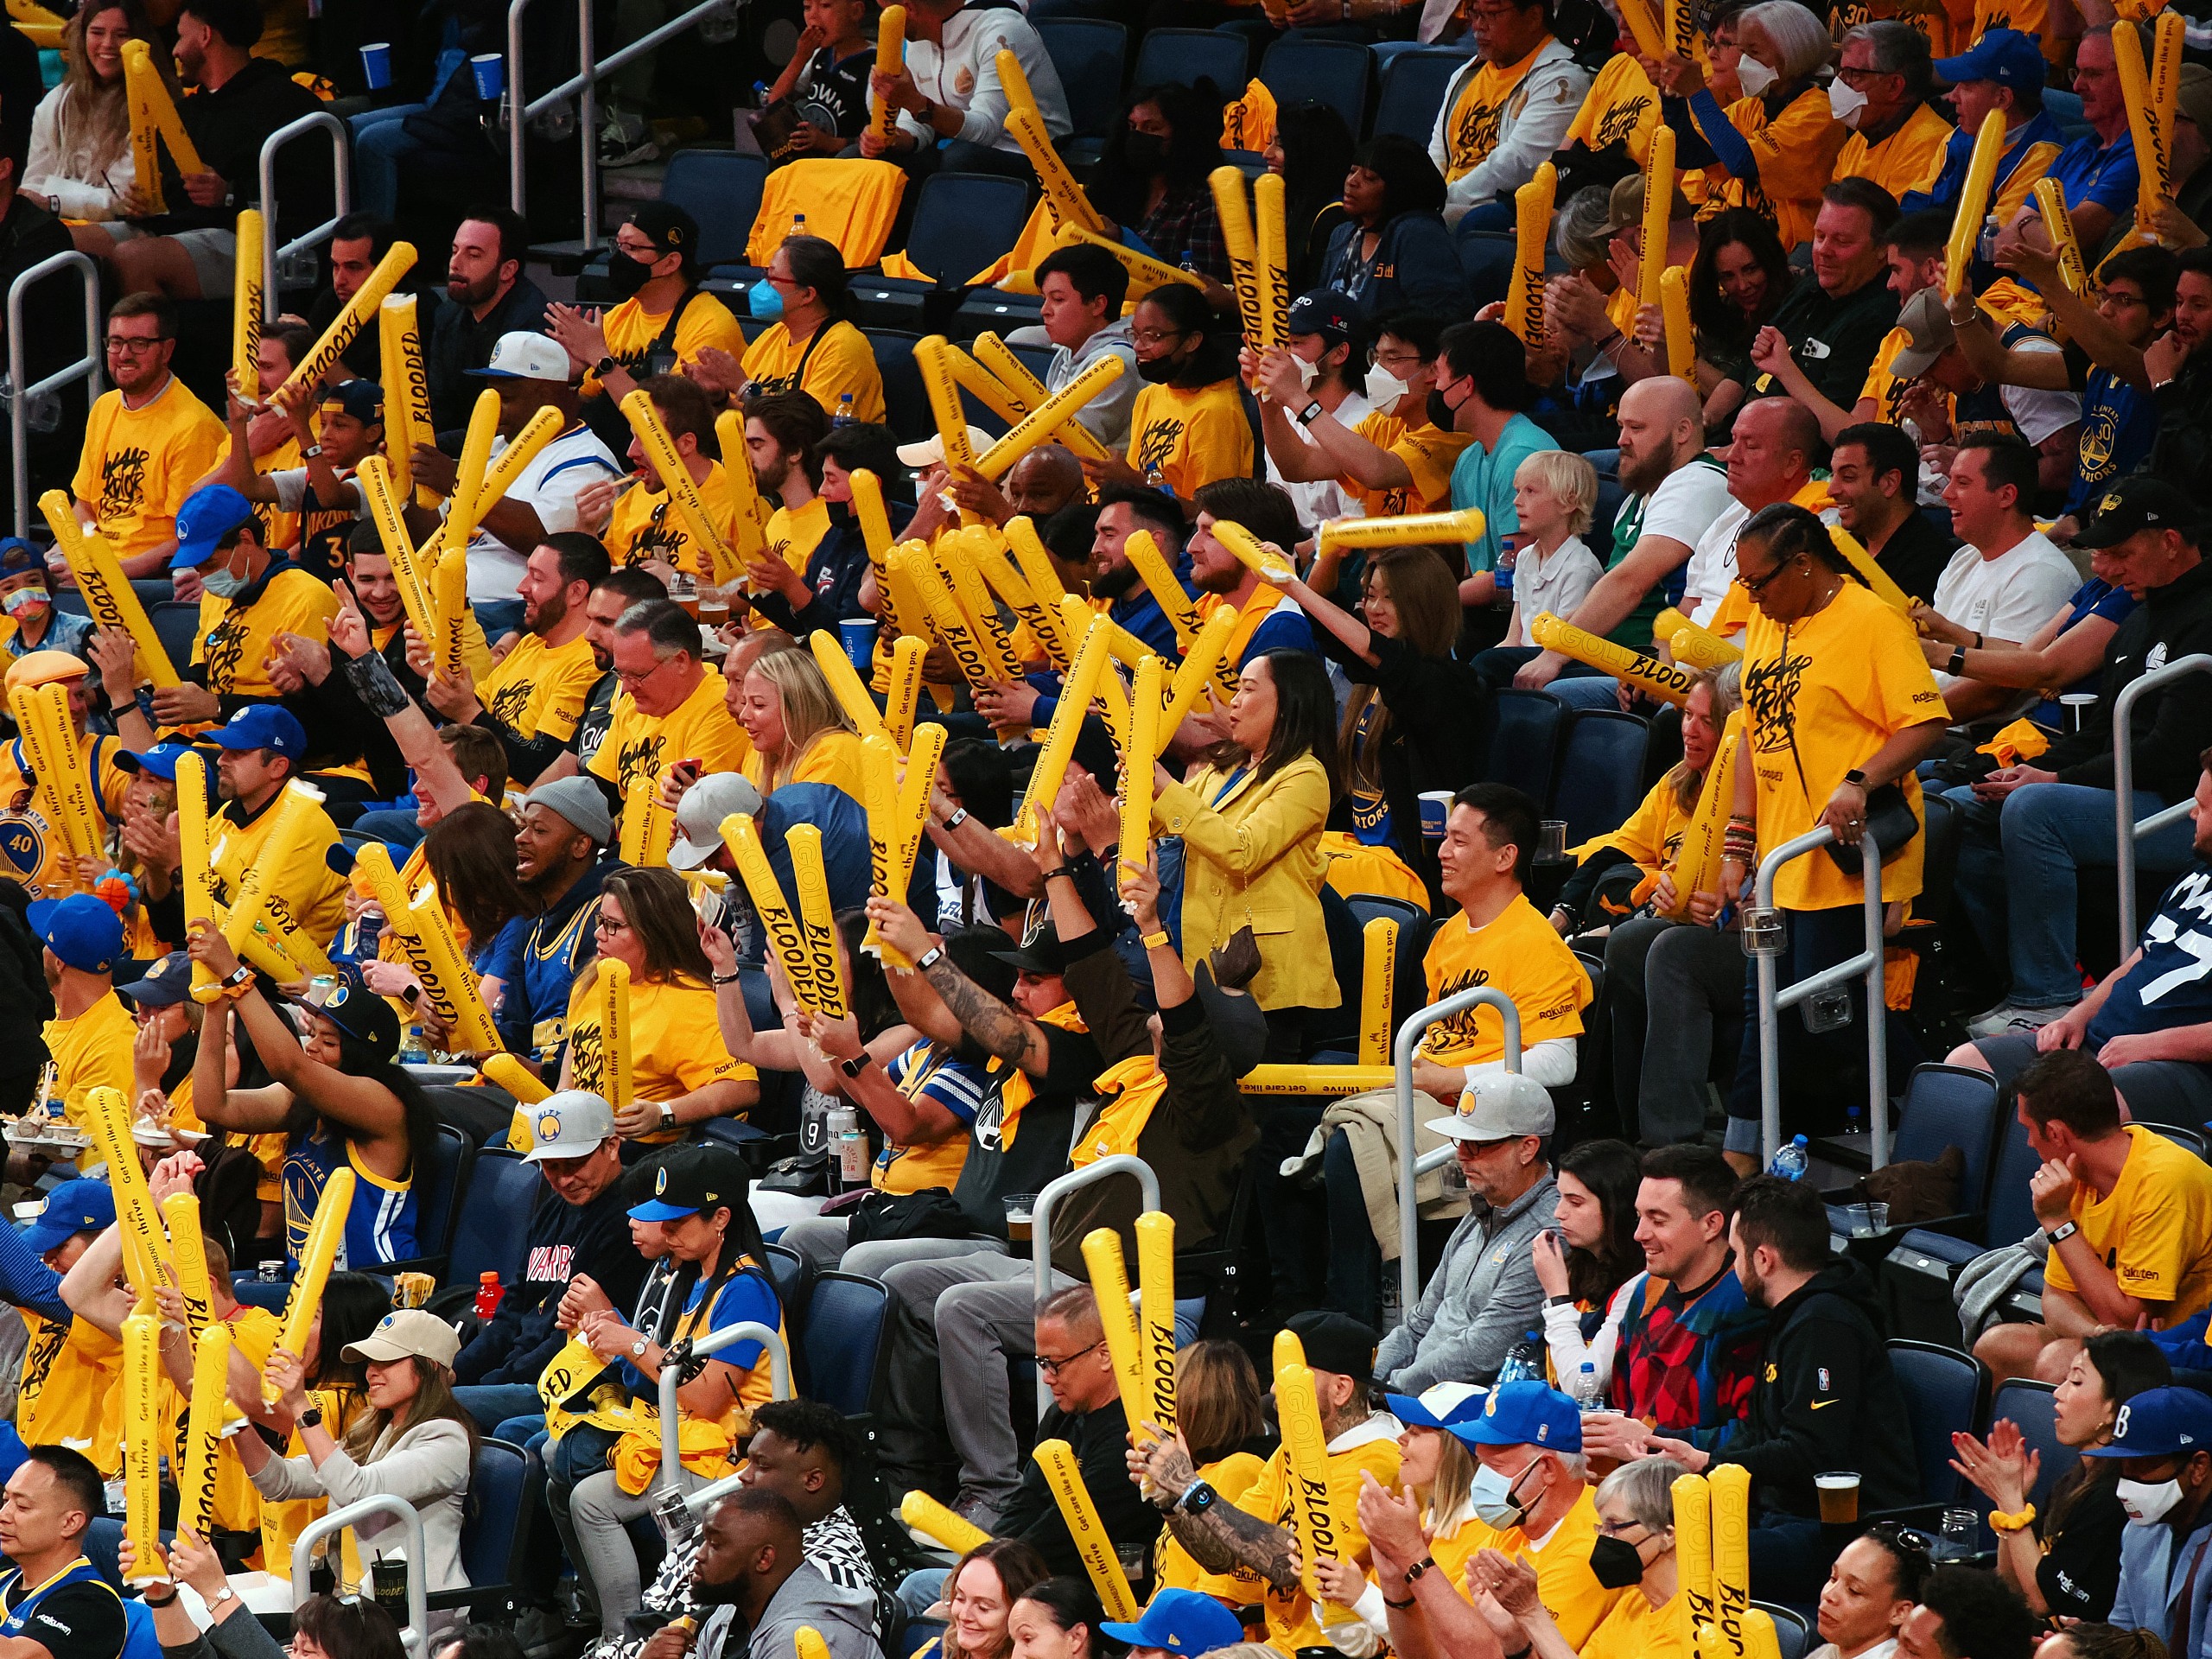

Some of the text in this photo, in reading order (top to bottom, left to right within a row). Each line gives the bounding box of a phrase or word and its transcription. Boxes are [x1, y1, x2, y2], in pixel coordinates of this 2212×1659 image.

[2160, 46, 2169, 63] like
[2158, 65, 2167, 84] care
[1032, 135, 1042, 149] like
[1039, 148, 1052, 163] care
[1049, 161, 1058, 174] Get
[1062, 180, 1079, 204] thrive
[1006, 353, 1020, 372] like
[402, 332, 432, 424] BLOODED
[1020, 370, 1033, 384] care
[1033, 382, 1046, 395] Get
[1007, 417, 1037, 441] thrive
[1046, 397, 1060, 410] Get
[1061, 384, 1077, 398] care
[1077, 372, 1093, 385] like
[646, 416, 658, 433] like
[497, 429, 536, 474] Get care like
[656, 433, 670, 454] care
[665, 451, 677, 467] Get
[680, 478, 698, 508] thrive
[378, 482, 411, 575] thrive Get care like
[904, 673, 912, 689] like
[902, 688, 911, 704] care
[1043, 647, 1086, 752] thrive Get care like
[65, 734, 73, 755] care
[24, 719, 61, 816] thrive Get care like
[925, 760, 935, 779] like
[74, 783, 86, 817] thrive
[921, 782, 931, 802] care
[916, 802, 925, 819] Get
[1352, 802, 1389, 829] RIORS
[9, 836, 32, 853] 40
[905, 834, 917, 868] thrive
[793, 840, 829, 925] GOLD
[397, 933, 458, 1025] BLOODED
[430, 910, 497, 1047] KAISER PERMANENTE. thrive Get care
[1540, 1002, 1575, 1020] Rakuten
[1243, 1083, 1360, 1093] thrive Get care like
[106, 1123, 118, 1141] like
[809, 1123, 818, 1145] 9
[114, 1145, 126, 1165] care
[122, 1166, 131, 1184] Get
[131, 1198, 149, 1236] thrive
[1225, 1267, 1236, 1275] 10
[141, 1402, 151, 1421] Get
[2113, 1405, 2131, 1439] B
[1284, 1384, 1322, 1481] GOLD
[140, 1439, 149, 1479] thrive
[196, 1432, 219, 1544] BLOODED
[1064, 1480, 1074, 1497] like
[1069, 1497, 1082, 1515] care
[1080, 1516, 1090, 1531] Get
[1718, 1484, 1745, 1586] GOLD
[1090, 1542, 1107, 1574] thrive
